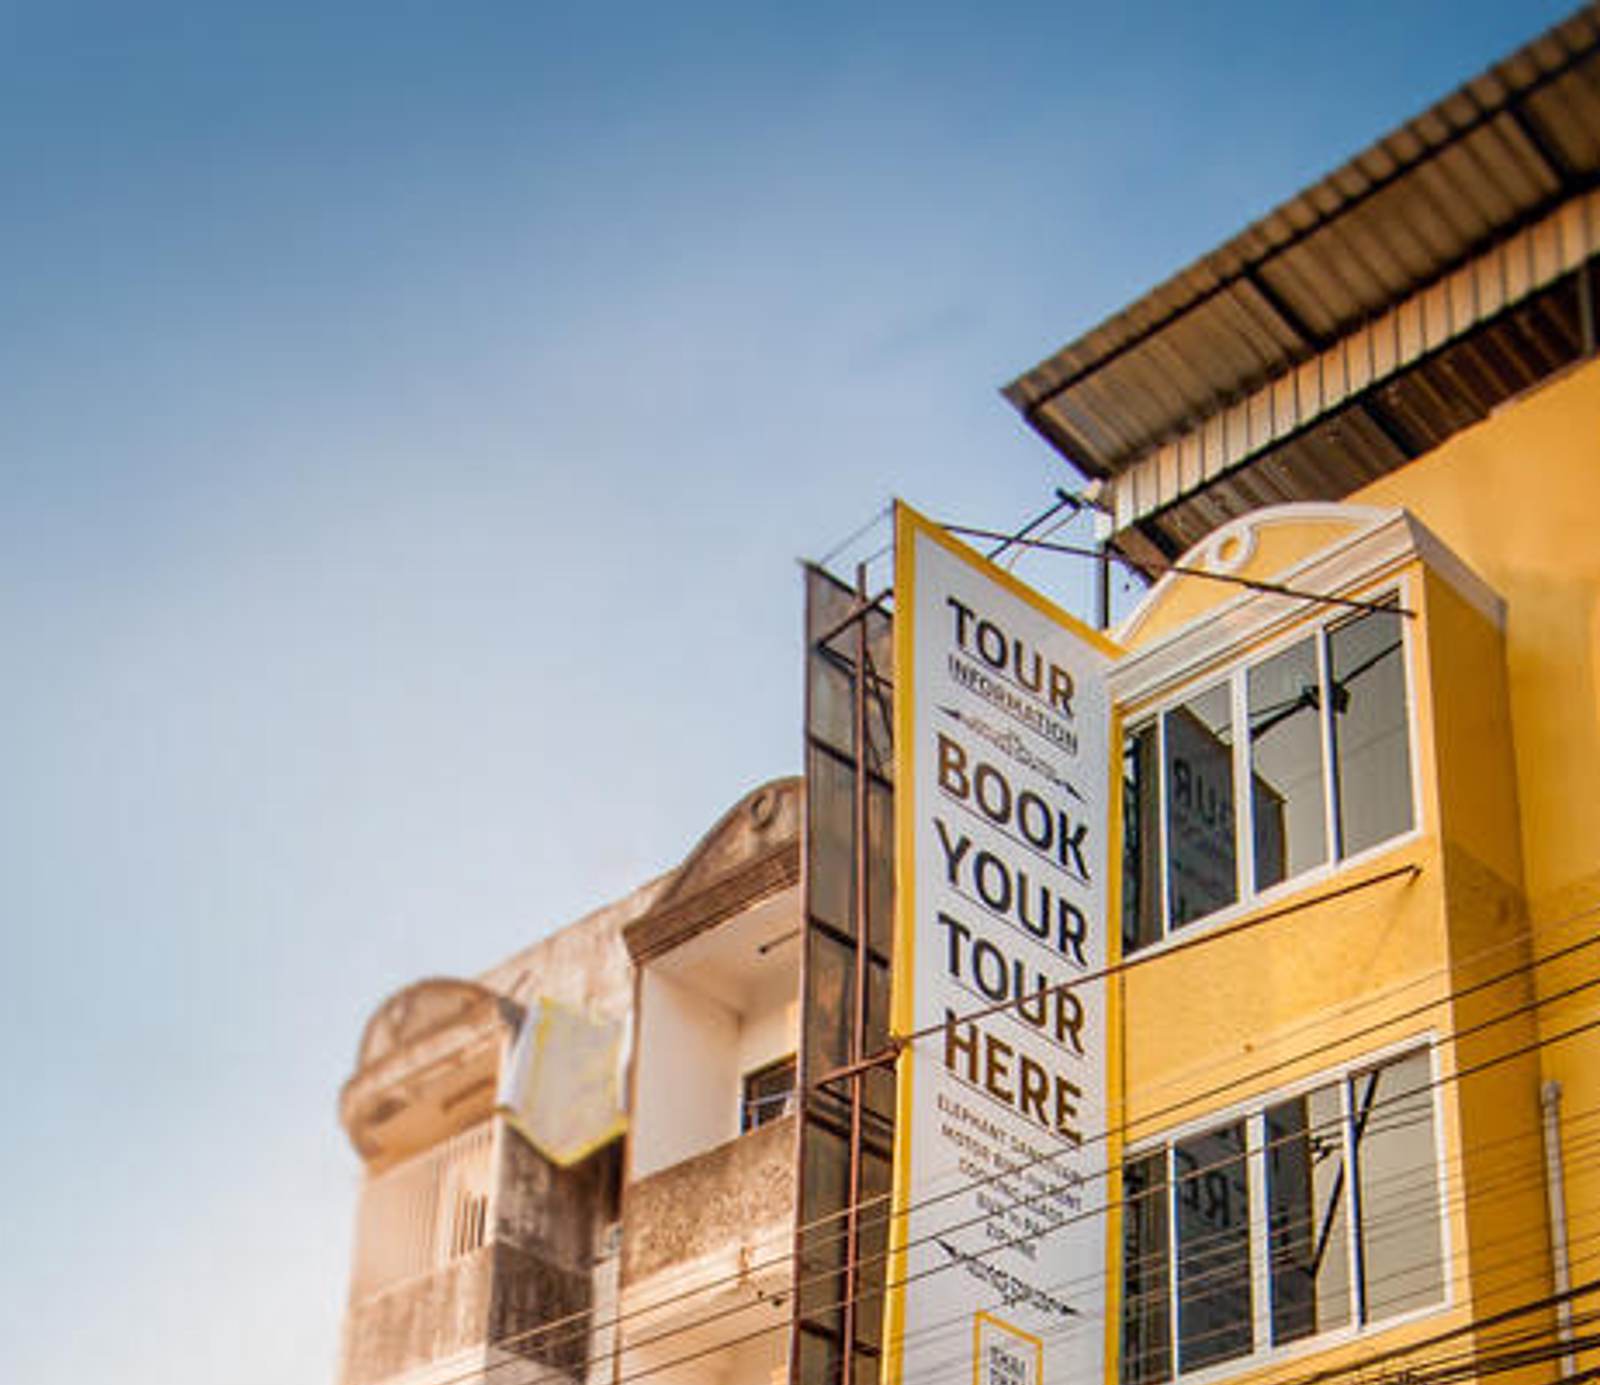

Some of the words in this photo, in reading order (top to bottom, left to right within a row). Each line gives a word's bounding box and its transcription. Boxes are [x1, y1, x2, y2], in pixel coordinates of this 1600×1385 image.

[946, 597, 1074, 719] TOUR
[948, 653, 1078, 757] INFORMATION
[937, 731, 1090, 880] BOOK
[933, 817, 1088, 967] YOUR
[938, 911, 1084, 1055] TOUR
[945, 1007, 1082, 1146] HERE
